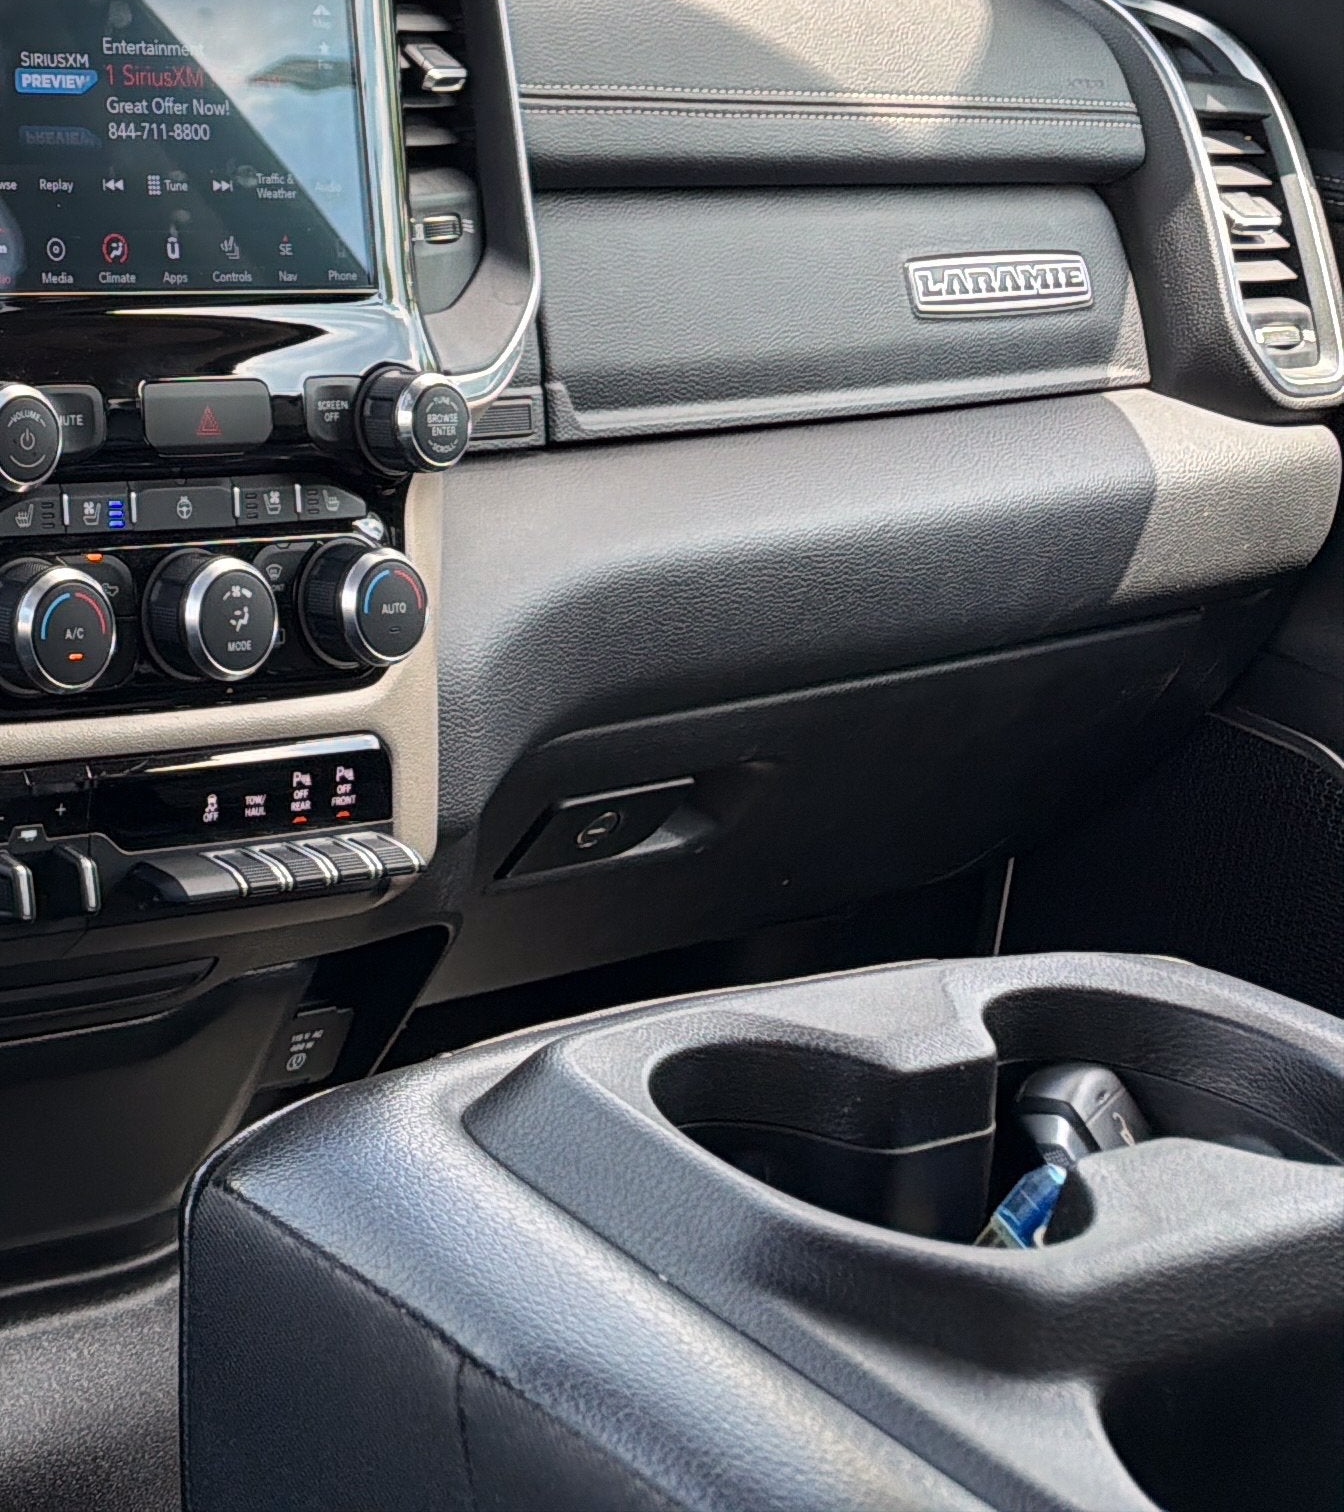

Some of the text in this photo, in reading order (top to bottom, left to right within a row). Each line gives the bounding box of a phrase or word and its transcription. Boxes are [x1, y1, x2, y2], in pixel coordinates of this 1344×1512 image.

[102, 37, 204, 58] Entertainment
[20, 51, 89, 69] SIRIUSXM
[21, 74, 90, 89] PREVIEW
[106, 64, 114, 86] 1
[122, 64, 205, 88] SiriusXM
[106, 96, 230, 117] Great Offer Now!
[108, 122, 211, 141] 844-711-8800
[165, 179, 189, 192] Tune
[256, 173, 295, 185] Traffic &
[39, 178, 74, 194] Replay
[256, 187, 297, 200] Weather
[278, 243, 294, 257] SE
[41, 272, 74, 285] Media
[98, 271, 137, 285] Climate
[163, 272, 189, 287] Apps
[212, 270, 253, 284] Controls
[278, 270, 298, 283] Nav
[327, 269, 358, 282] Phone
[917, 265, 1086, 299] LARAMIE
[317, 399, 349, 411] SCREEN
[10, 409, 42, 423] VOLUME
[324, 412, 340, 423] OFF
[426, 412, 459, 424] BROWSE
[431, 425, 457, 437] ENTER
[431, 442, 456, 454] SCROLL
[381, 602, 407, 615] AUTO
[64, 627, 85, 640] A/C
[226, 640, 252, 652] MODE
[293, 789, 309, 801] OFF
[336, 783, 352, 794] OFF
[244, 794, 267, 806] TOW/
[290, 800, 312, 812] REAR
[330, 794, 357, 807] FRONT
[203, 812, 220, 824] OFF
[244, 806, 267, 818] HAUL
